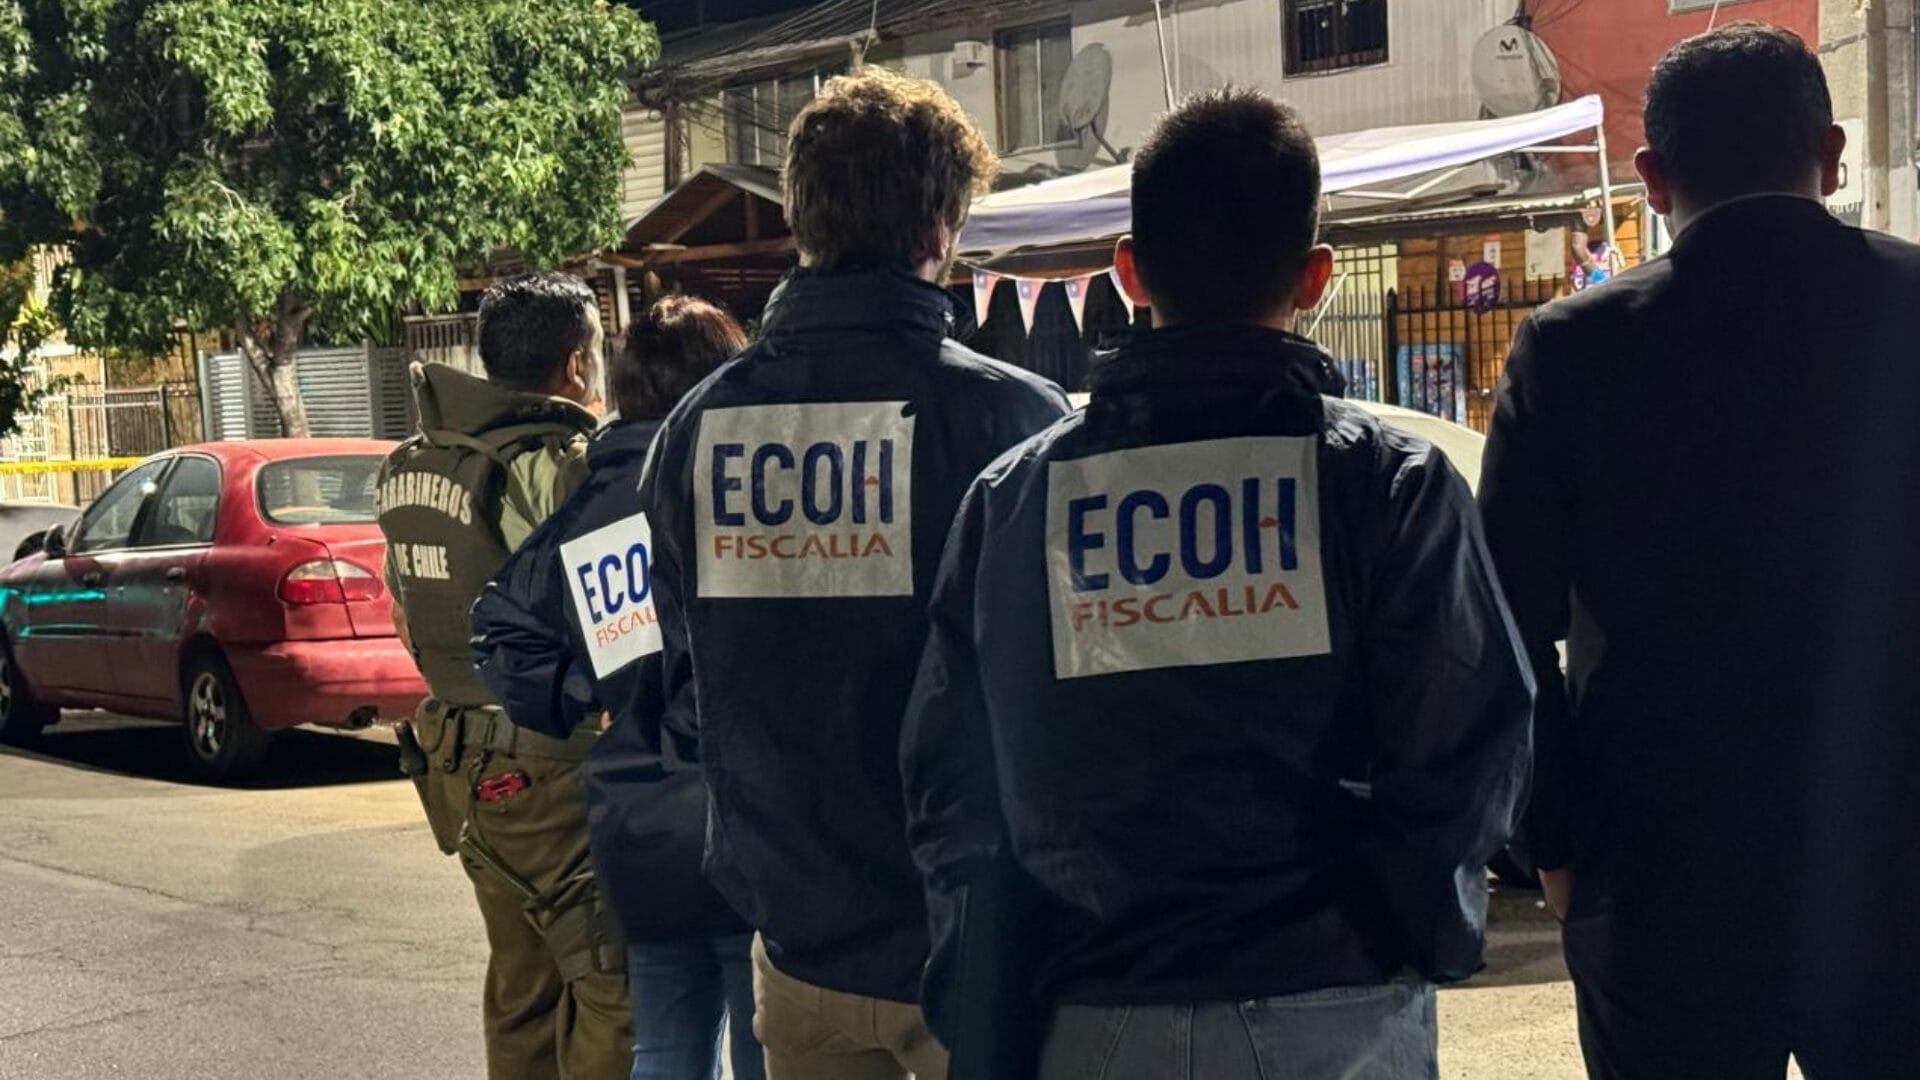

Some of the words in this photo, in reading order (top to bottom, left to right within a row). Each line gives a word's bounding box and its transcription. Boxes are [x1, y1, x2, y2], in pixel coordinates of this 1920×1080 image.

[711, 438, 895, 527] ECOH
[713, 533, 895, 561] FISCALIA
[1067, 476, 1299, 593] ECOH
[412, 543, 451, 580] CHILE
[1069, 581, 1300, 633] FISCALIA
